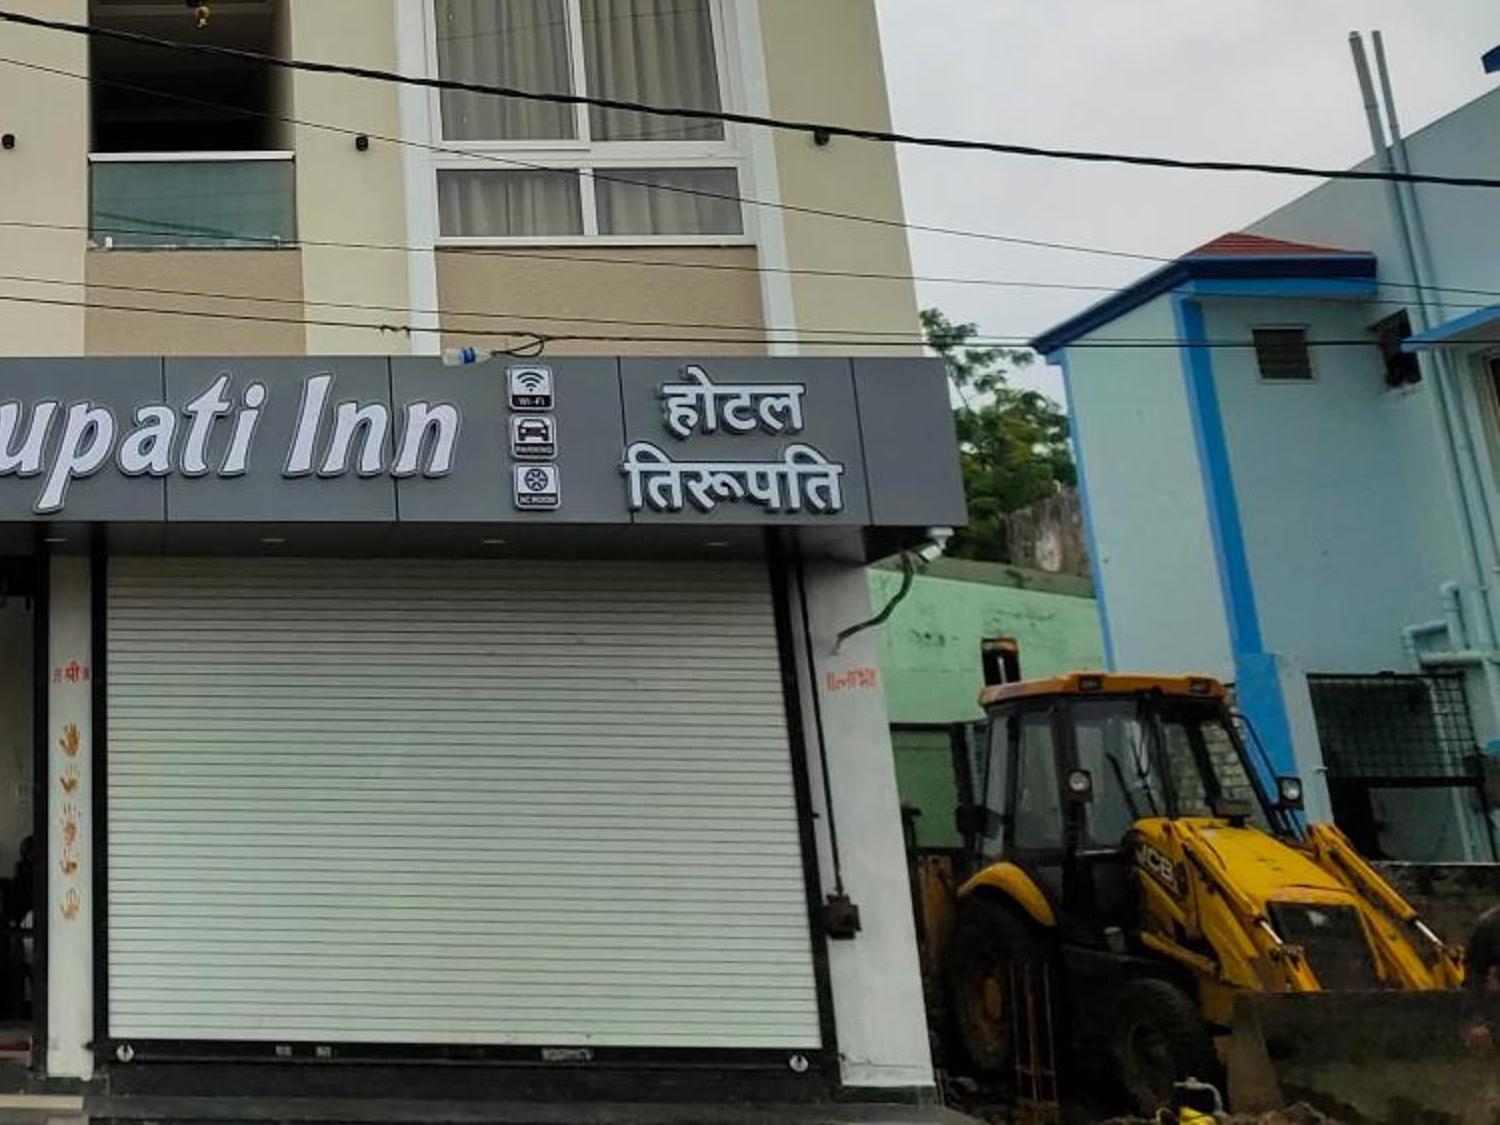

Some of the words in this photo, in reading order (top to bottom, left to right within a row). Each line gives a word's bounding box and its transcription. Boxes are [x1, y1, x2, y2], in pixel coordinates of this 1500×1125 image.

[282, 373, 461, 478] Inn
[660, 365, 806, 437] होटल
[1135, 843, 1174, 883] JCB
